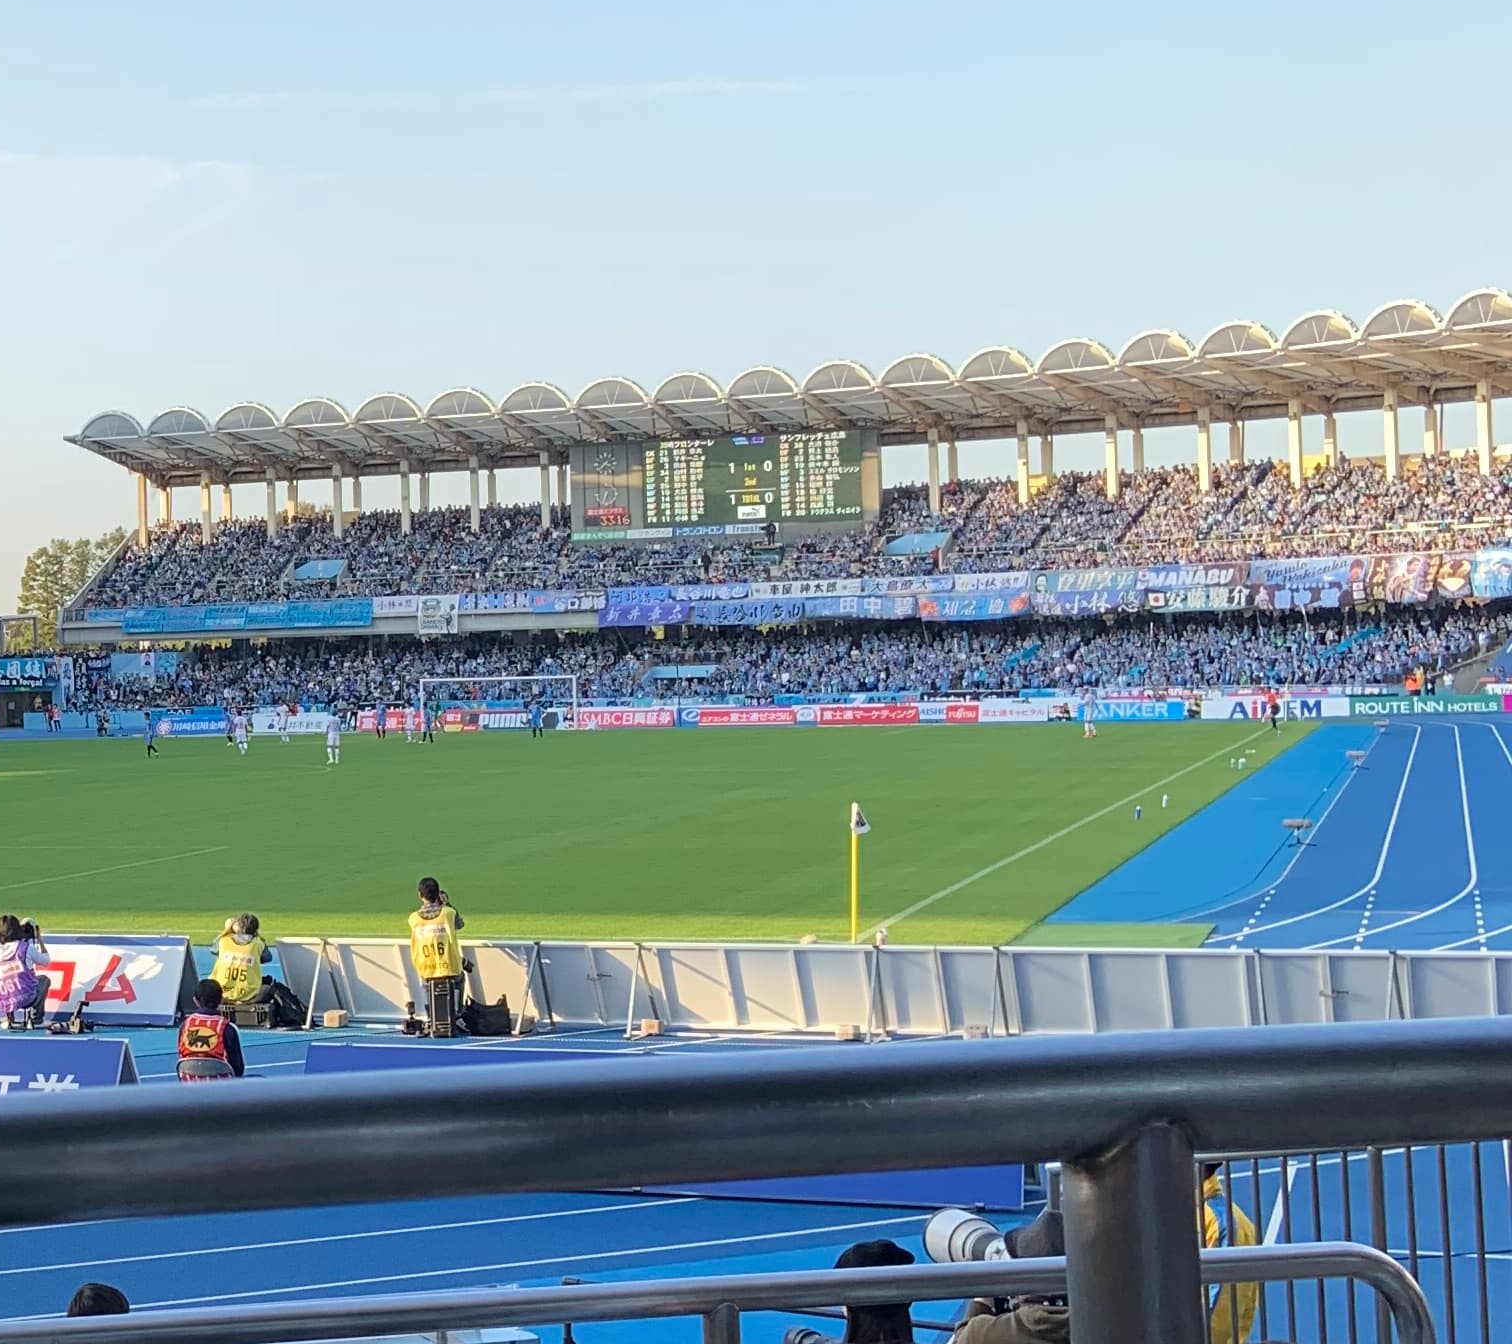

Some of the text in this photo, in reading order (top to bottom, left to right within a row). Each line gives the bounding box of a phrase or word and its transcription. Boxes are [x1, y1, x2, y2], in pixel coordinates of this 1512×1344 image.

[1092, 702, 1169, 718] ANKER
[1355, 701, 1409, 715] ROUTE
[1447, 700, 1499, 713] HOTELS
